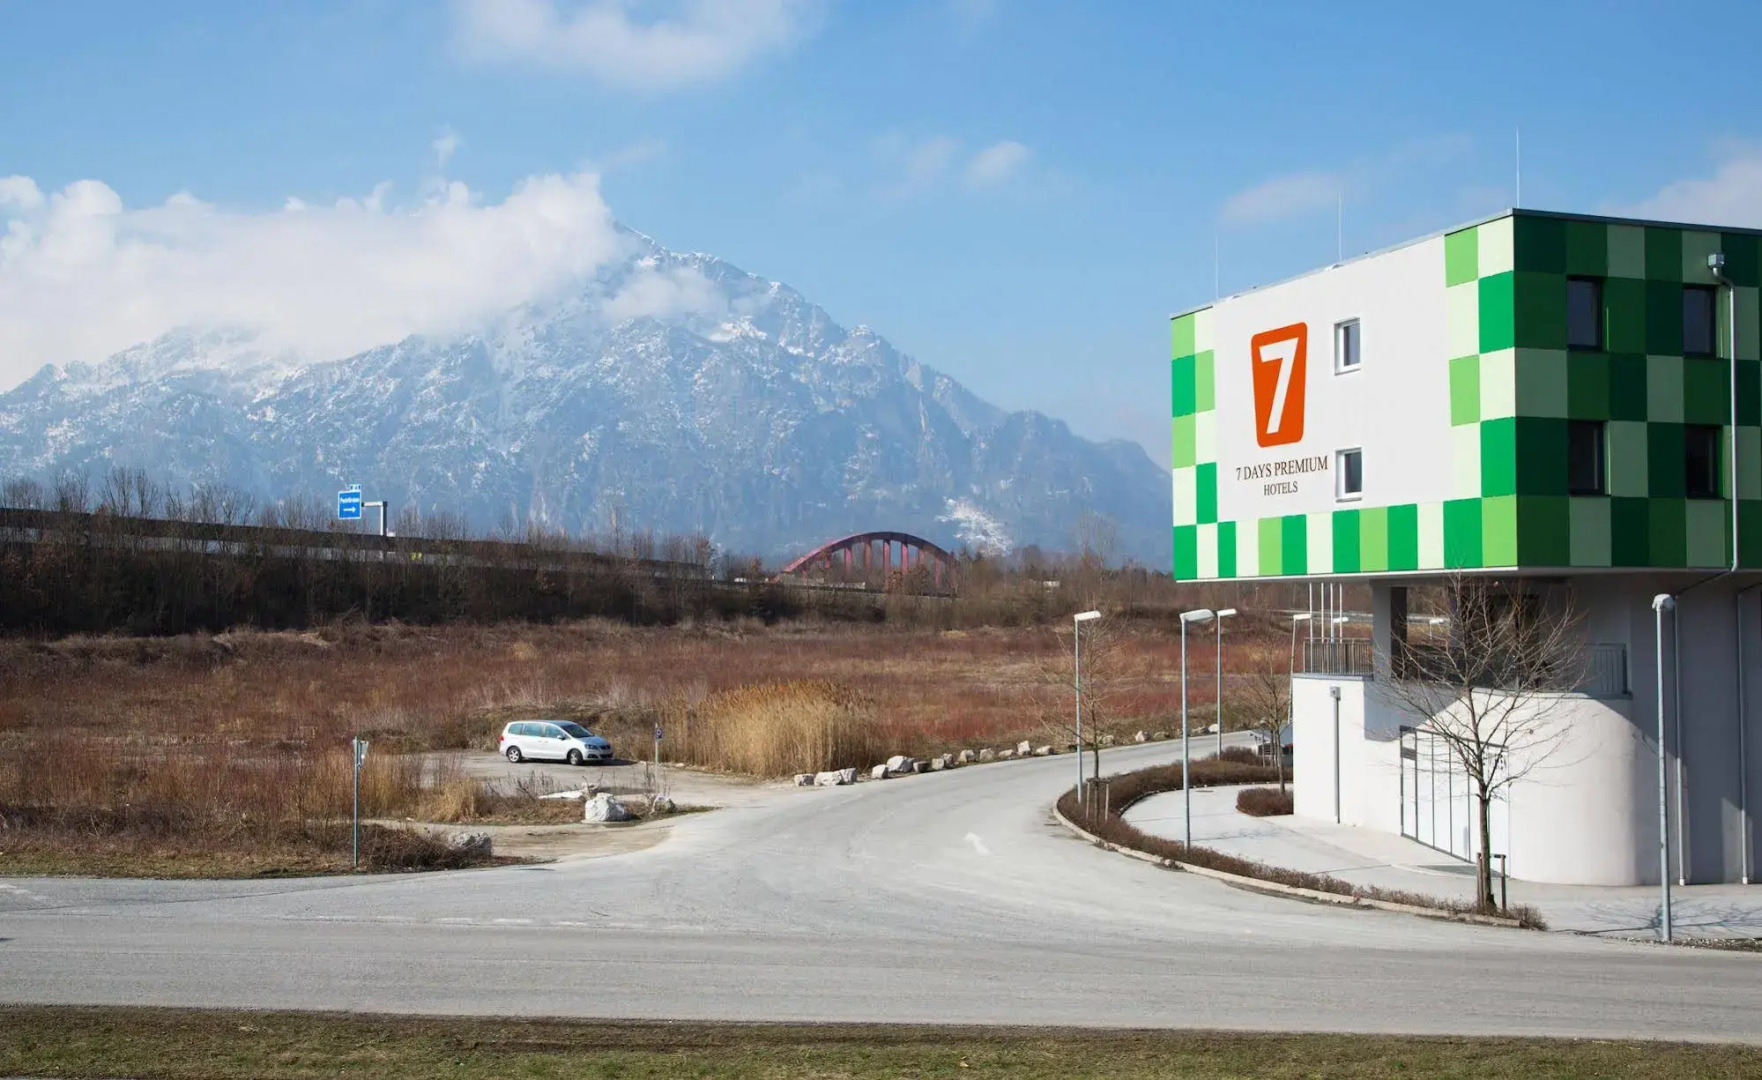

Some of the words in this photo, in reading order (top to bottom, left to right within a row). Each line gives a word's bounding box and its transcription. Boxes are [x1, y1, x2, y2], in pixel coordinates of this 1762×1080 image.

[1259, 336, 1300, 435] 7
[1236, 467, 1242, 481] 7
[1243, 463, 1272, 481] DAYS
[1274, 455, 1328, 476] PREMIUM
[1263, 481, 1299, 496] HOTELS
